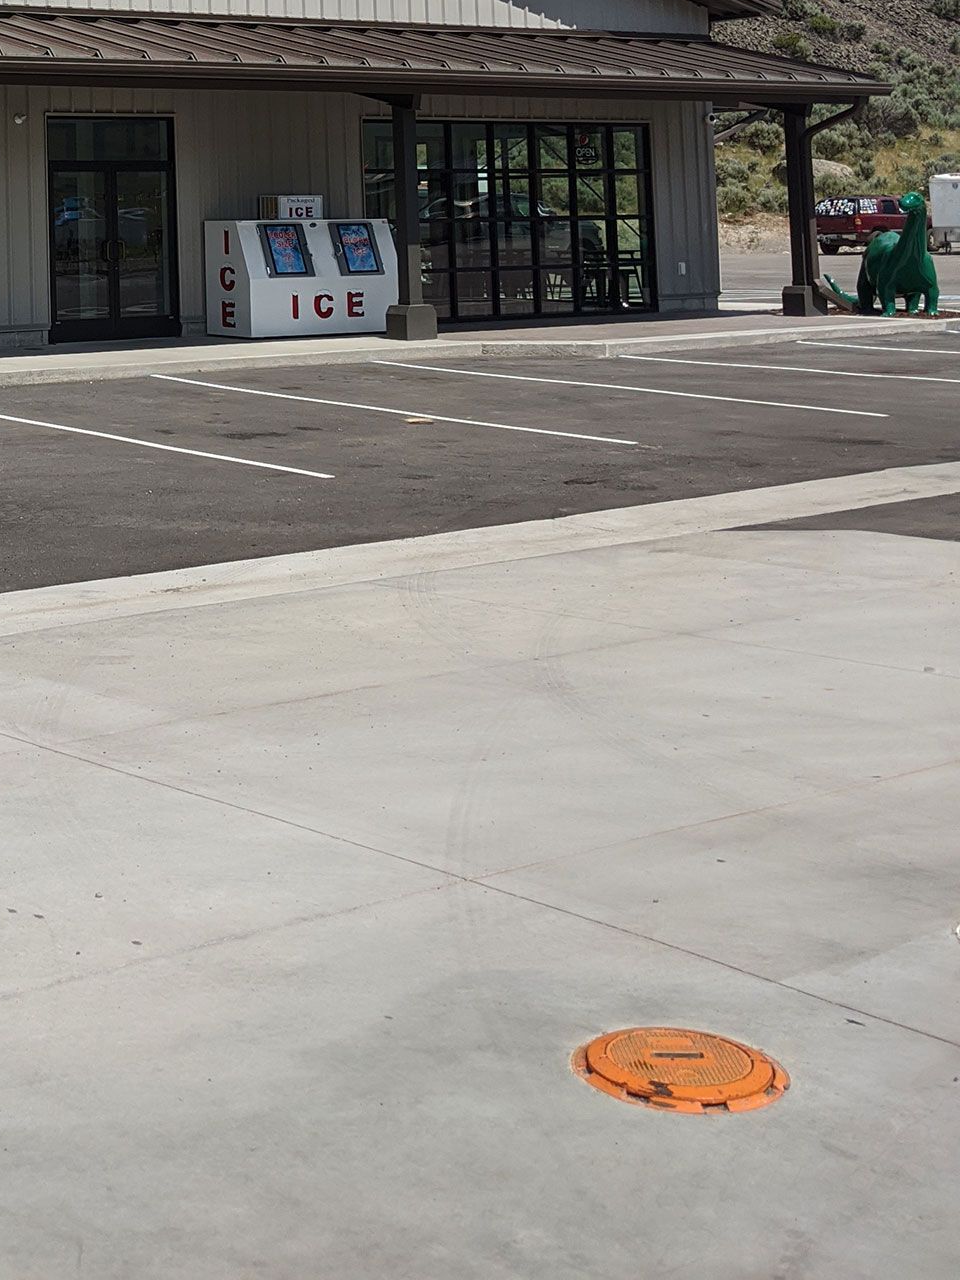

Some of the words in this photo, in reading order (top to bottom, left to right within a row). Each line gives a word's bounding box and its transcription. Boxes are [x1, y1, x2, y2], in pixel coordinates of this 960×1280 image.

[288, 206, 314, 218] ICE
[219, 228, 236, 329] ICE
[291, 290, 365, 320] ICE
